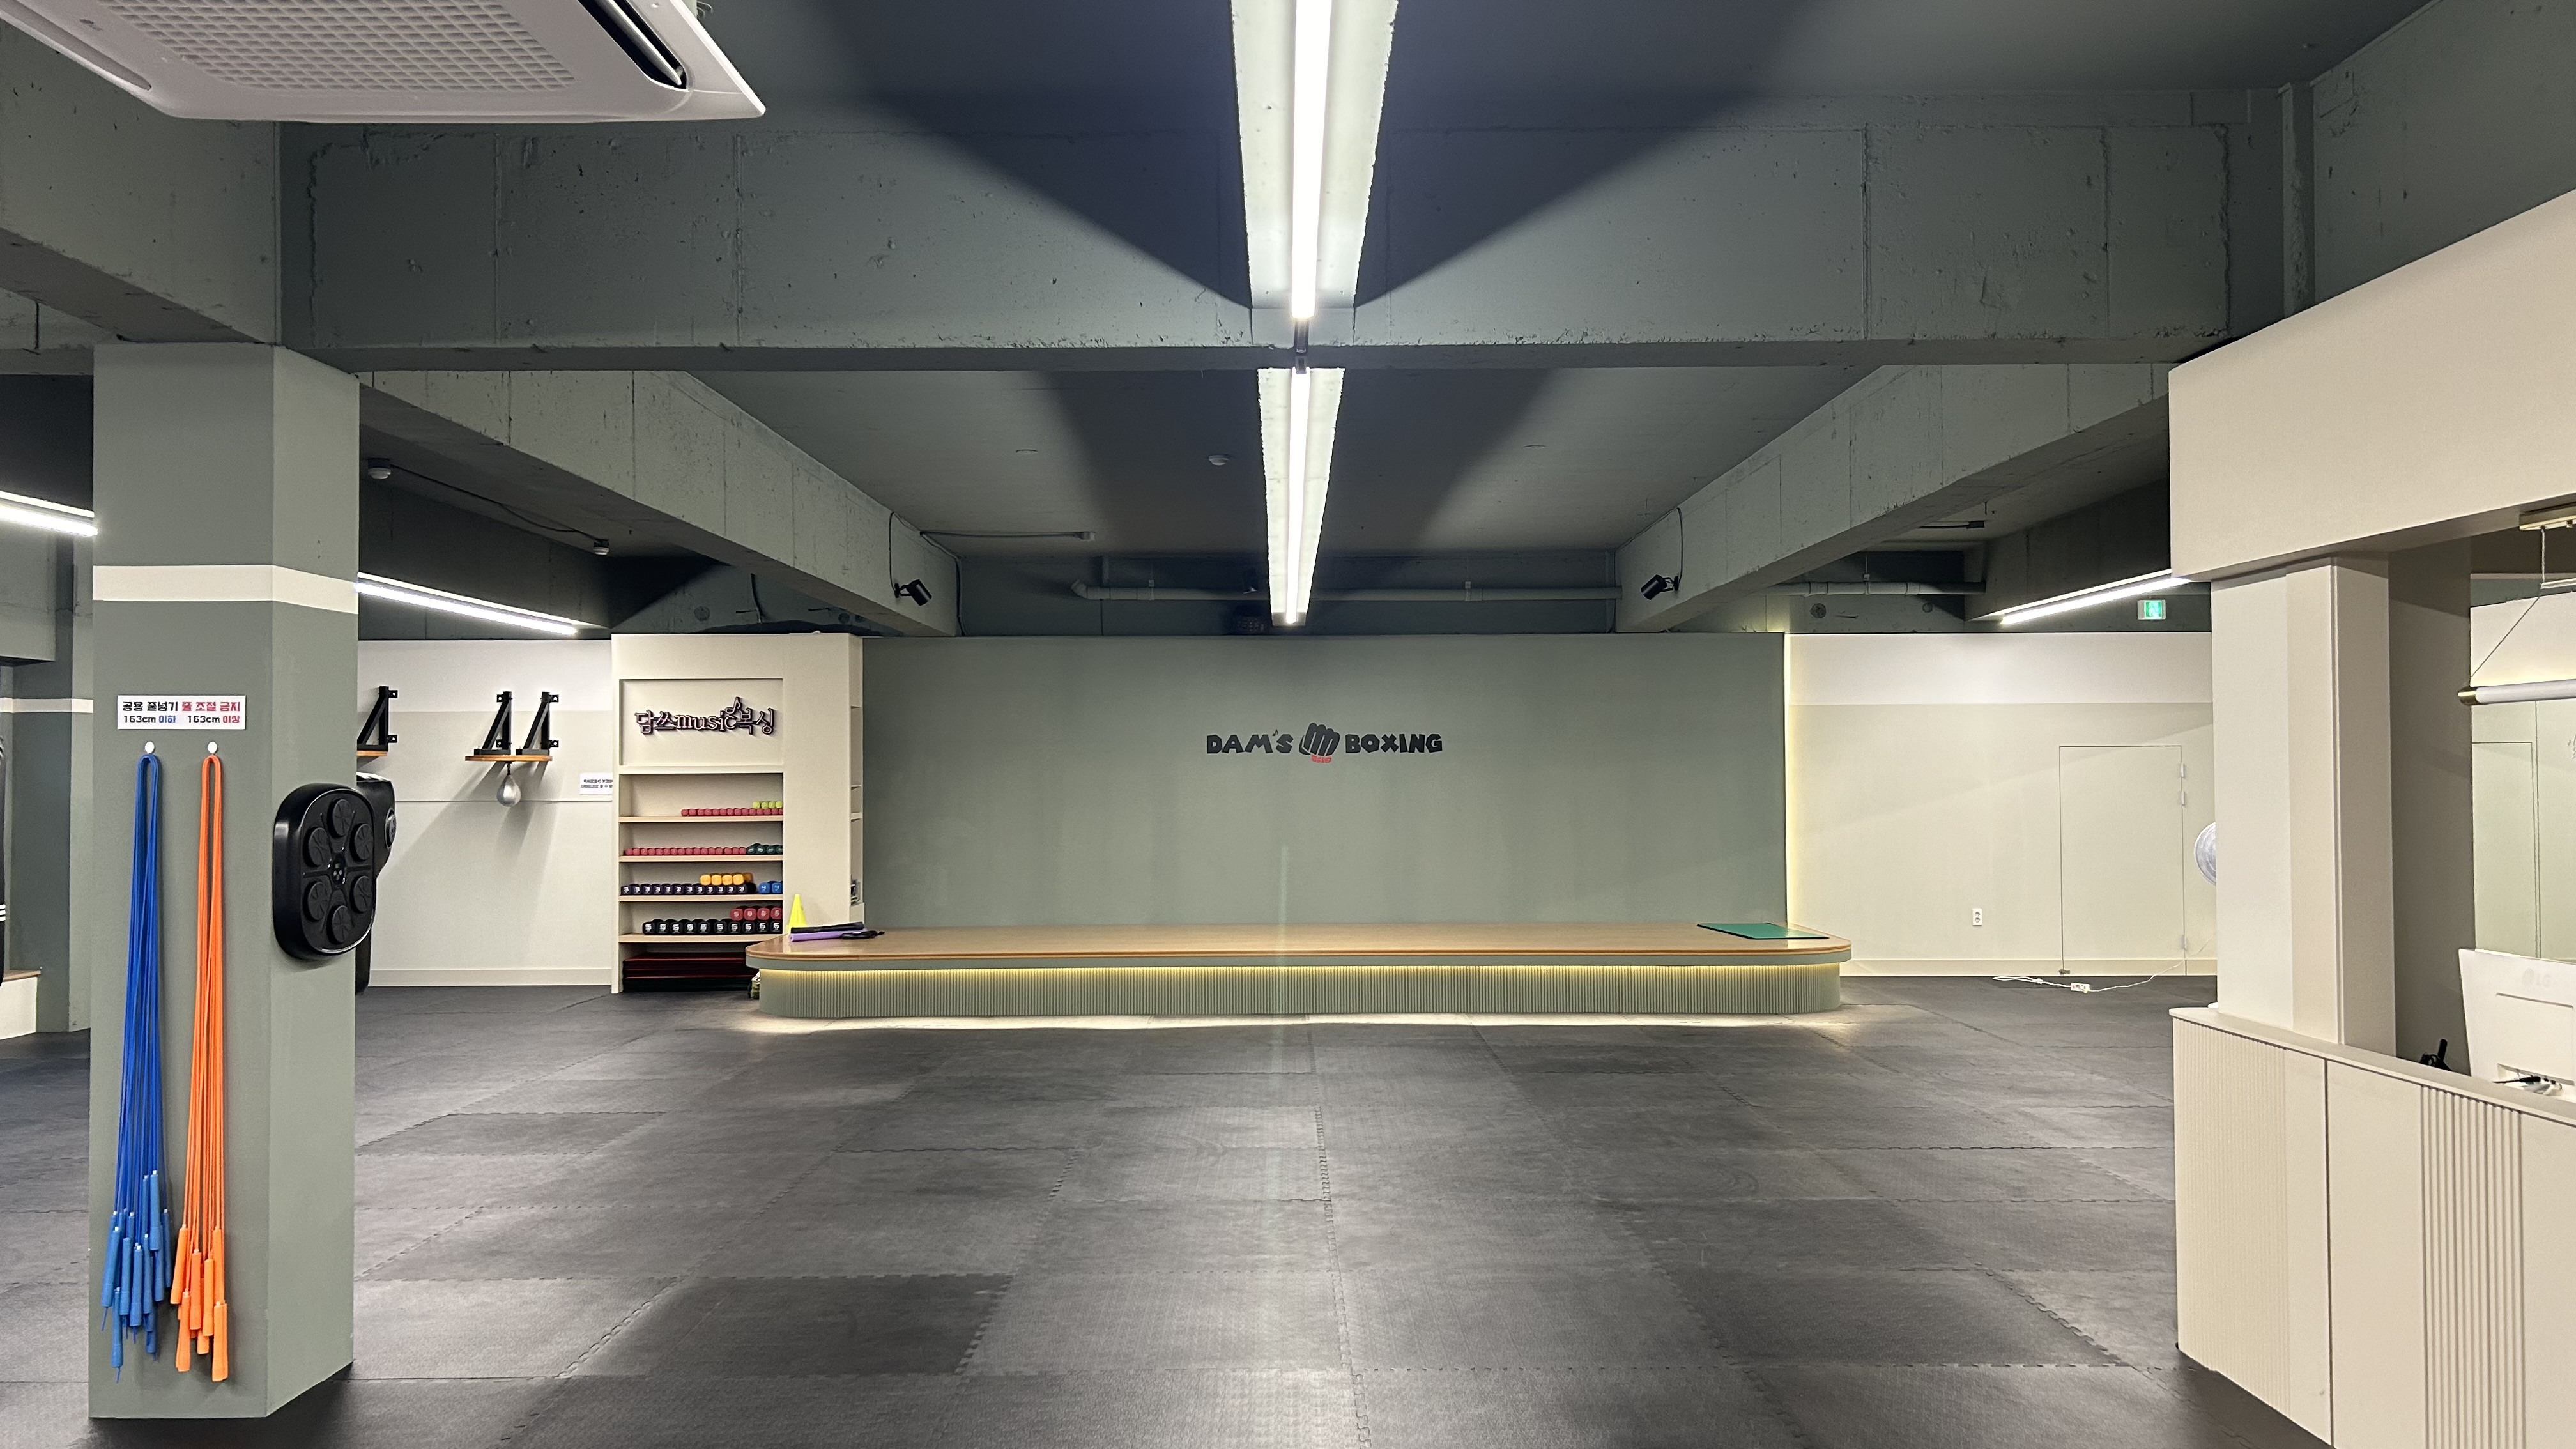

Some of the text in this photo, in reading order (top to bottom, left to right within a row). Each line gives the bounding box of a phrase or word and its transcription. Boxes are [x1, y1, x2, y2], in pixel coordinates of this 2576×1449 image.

[122, 702, 241, 712] 공용 줄넘기 줄 조절 금지
[123, 715, 177, 723] 163cm 이하
[187, 715, 240, 723] 163cm 이상
[1206, 730, 1443, 754] DAM'S BOXING
